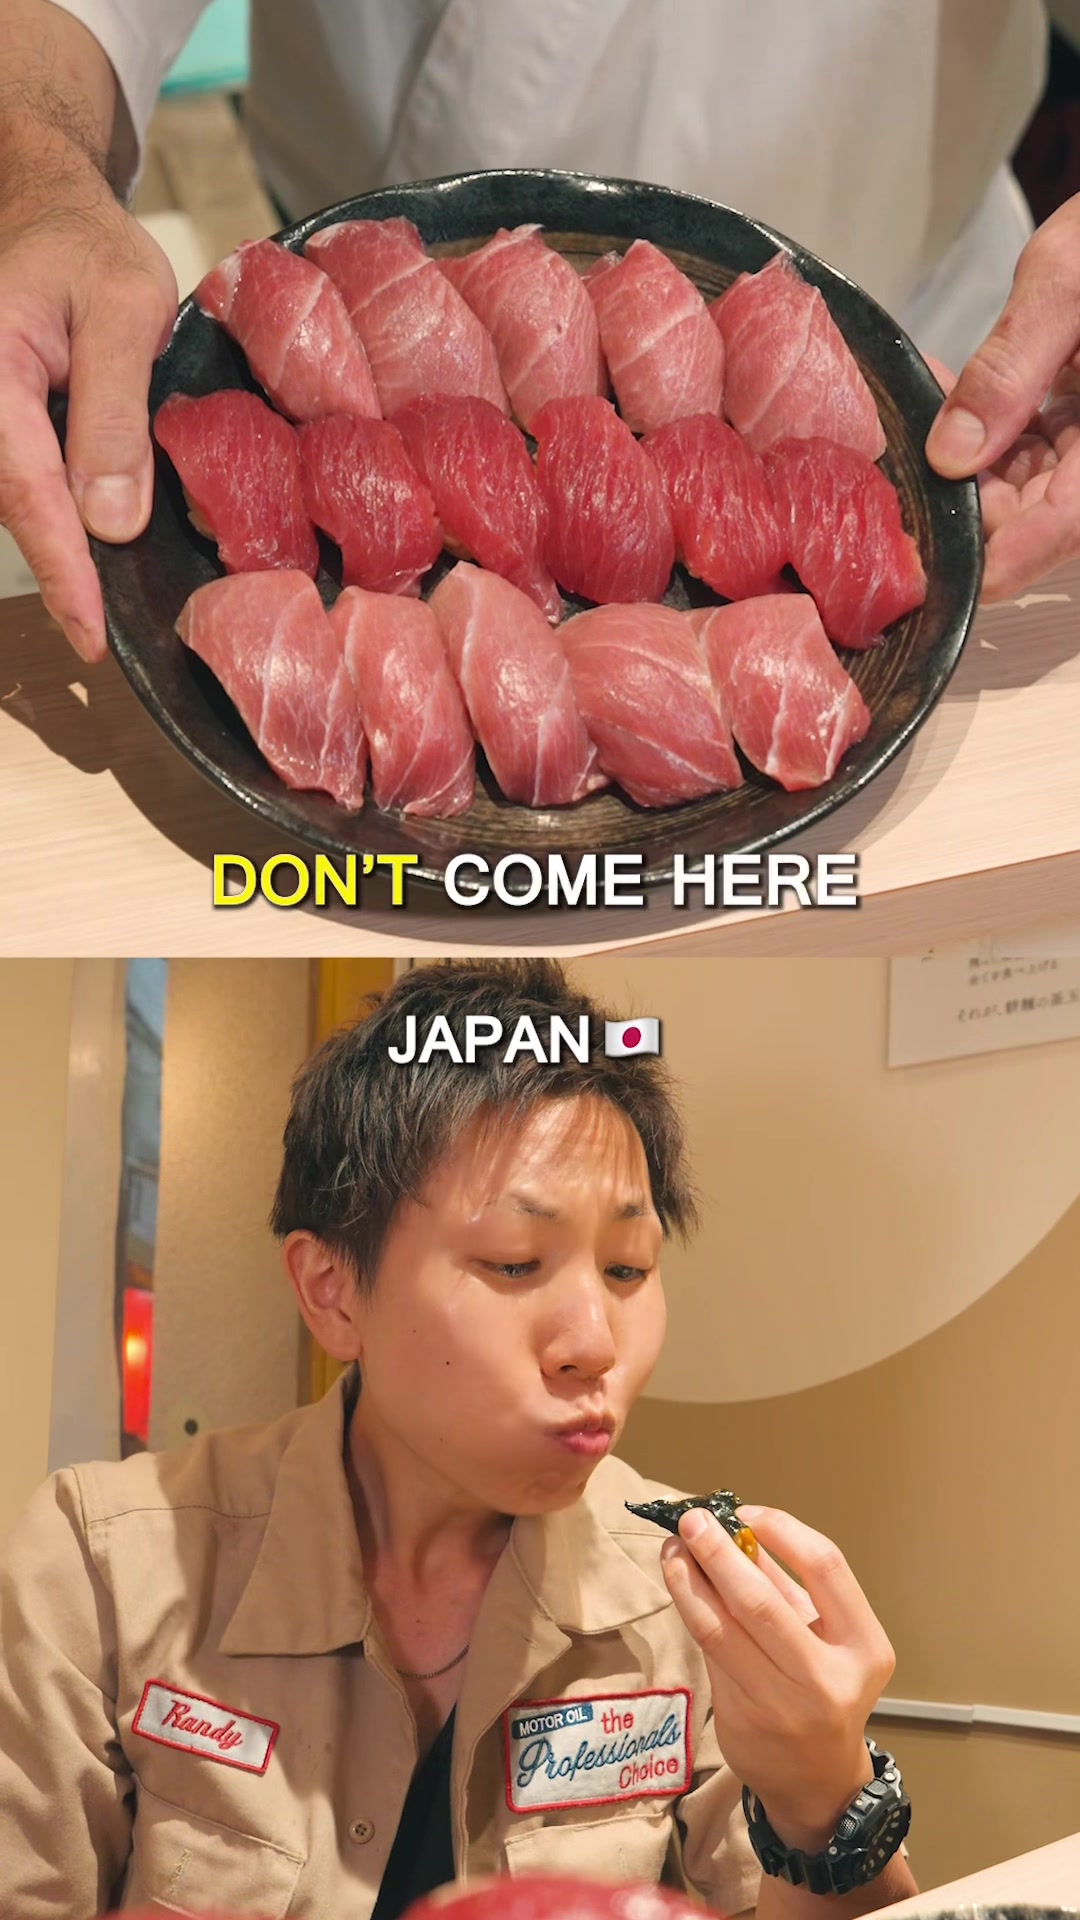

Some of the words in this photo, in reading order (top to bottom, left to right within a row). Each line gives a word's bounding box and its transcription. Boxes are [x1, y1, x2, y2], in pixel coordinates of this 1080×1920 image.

[161, 1698, 243, 1751] Randy
[519, 1712, 563, 1737] MOTOR
[565, 1706, 588, 1724] OIL
[601, 1708, 634, 1735] the
[516, 1712, 682, 1789] Professionals
[618, 1754, 680, 1790] Choice
